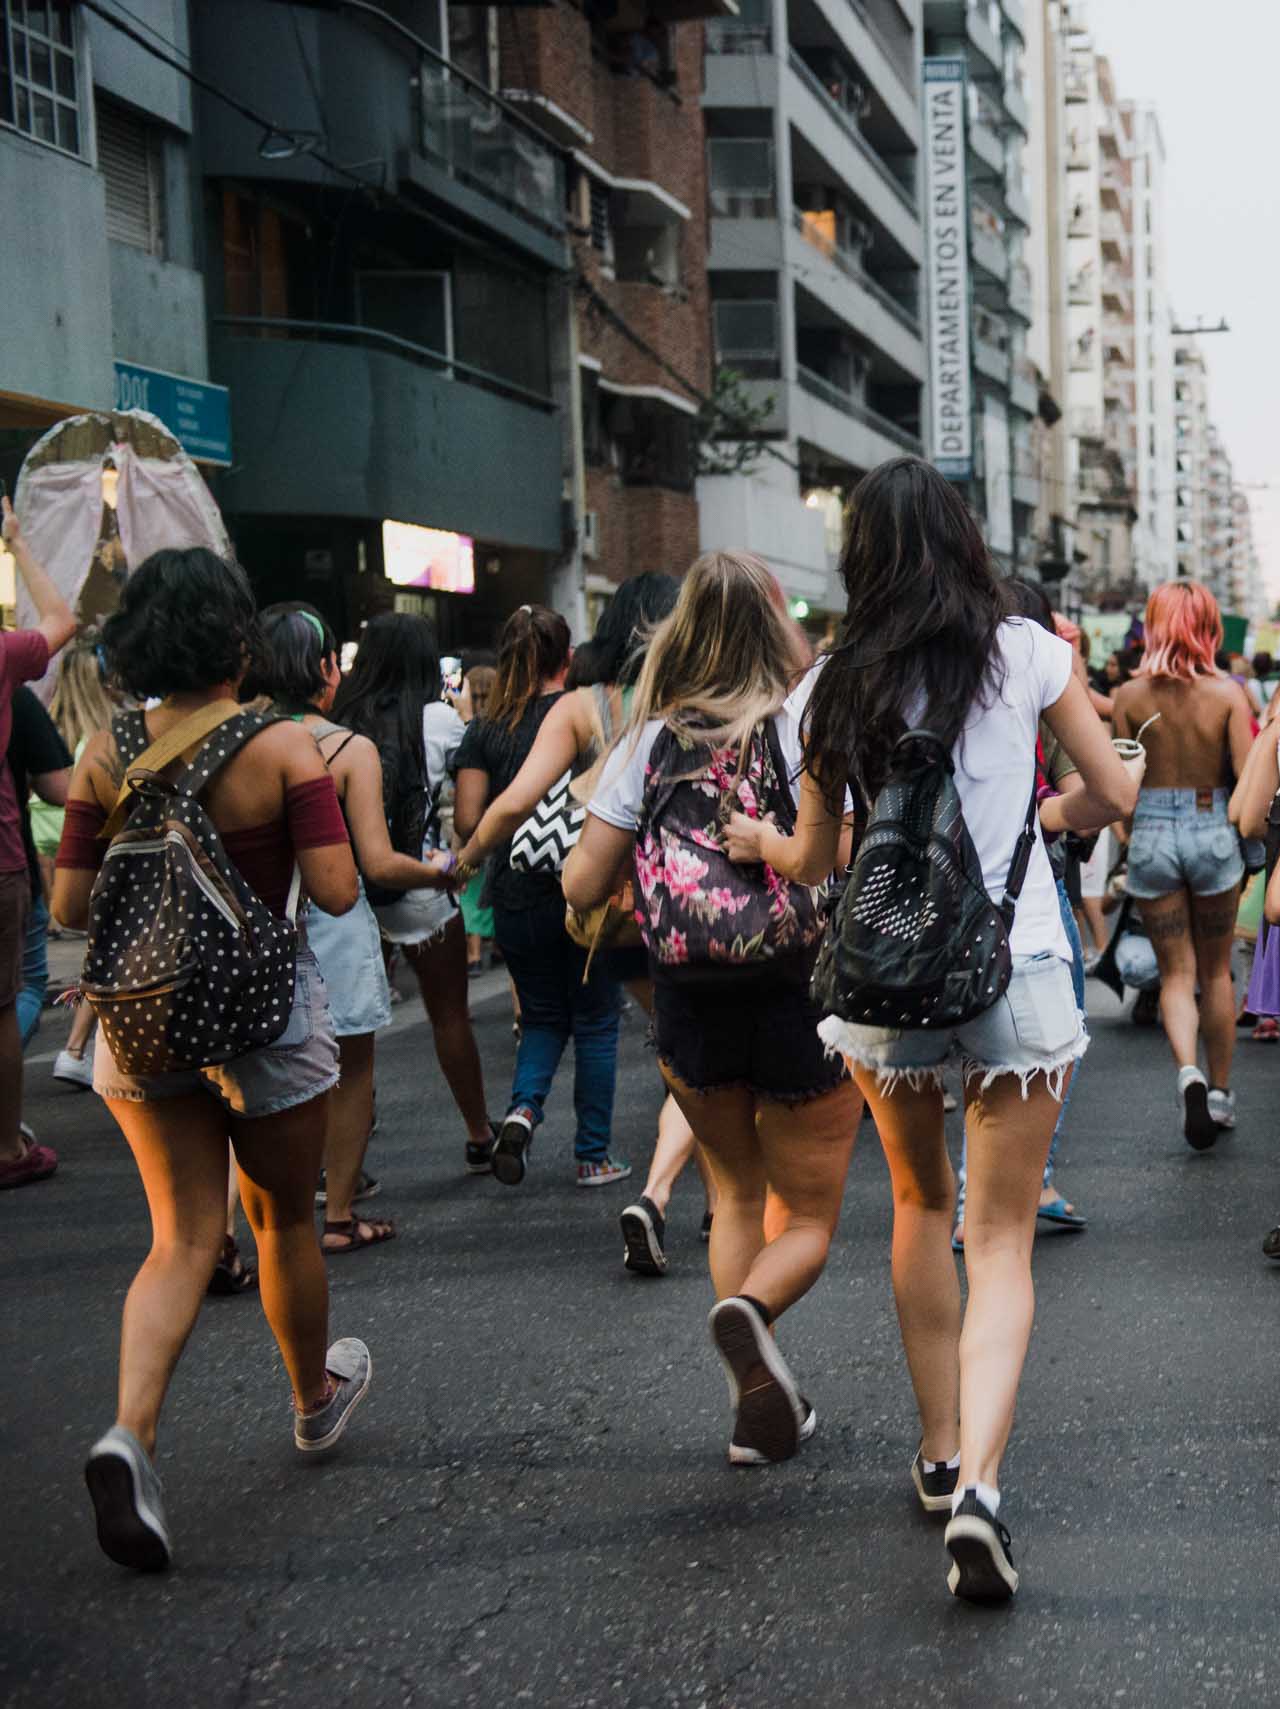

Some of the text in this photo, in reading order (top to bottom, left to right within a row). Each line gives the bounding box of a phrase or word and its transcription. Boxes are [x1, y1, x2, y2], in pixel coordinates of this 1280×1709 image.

[933, 90, 956, 175] VENTA
[935, 184, 958, 216] EN
[935, 226, 962, 453] DEPARTAMENTOS
